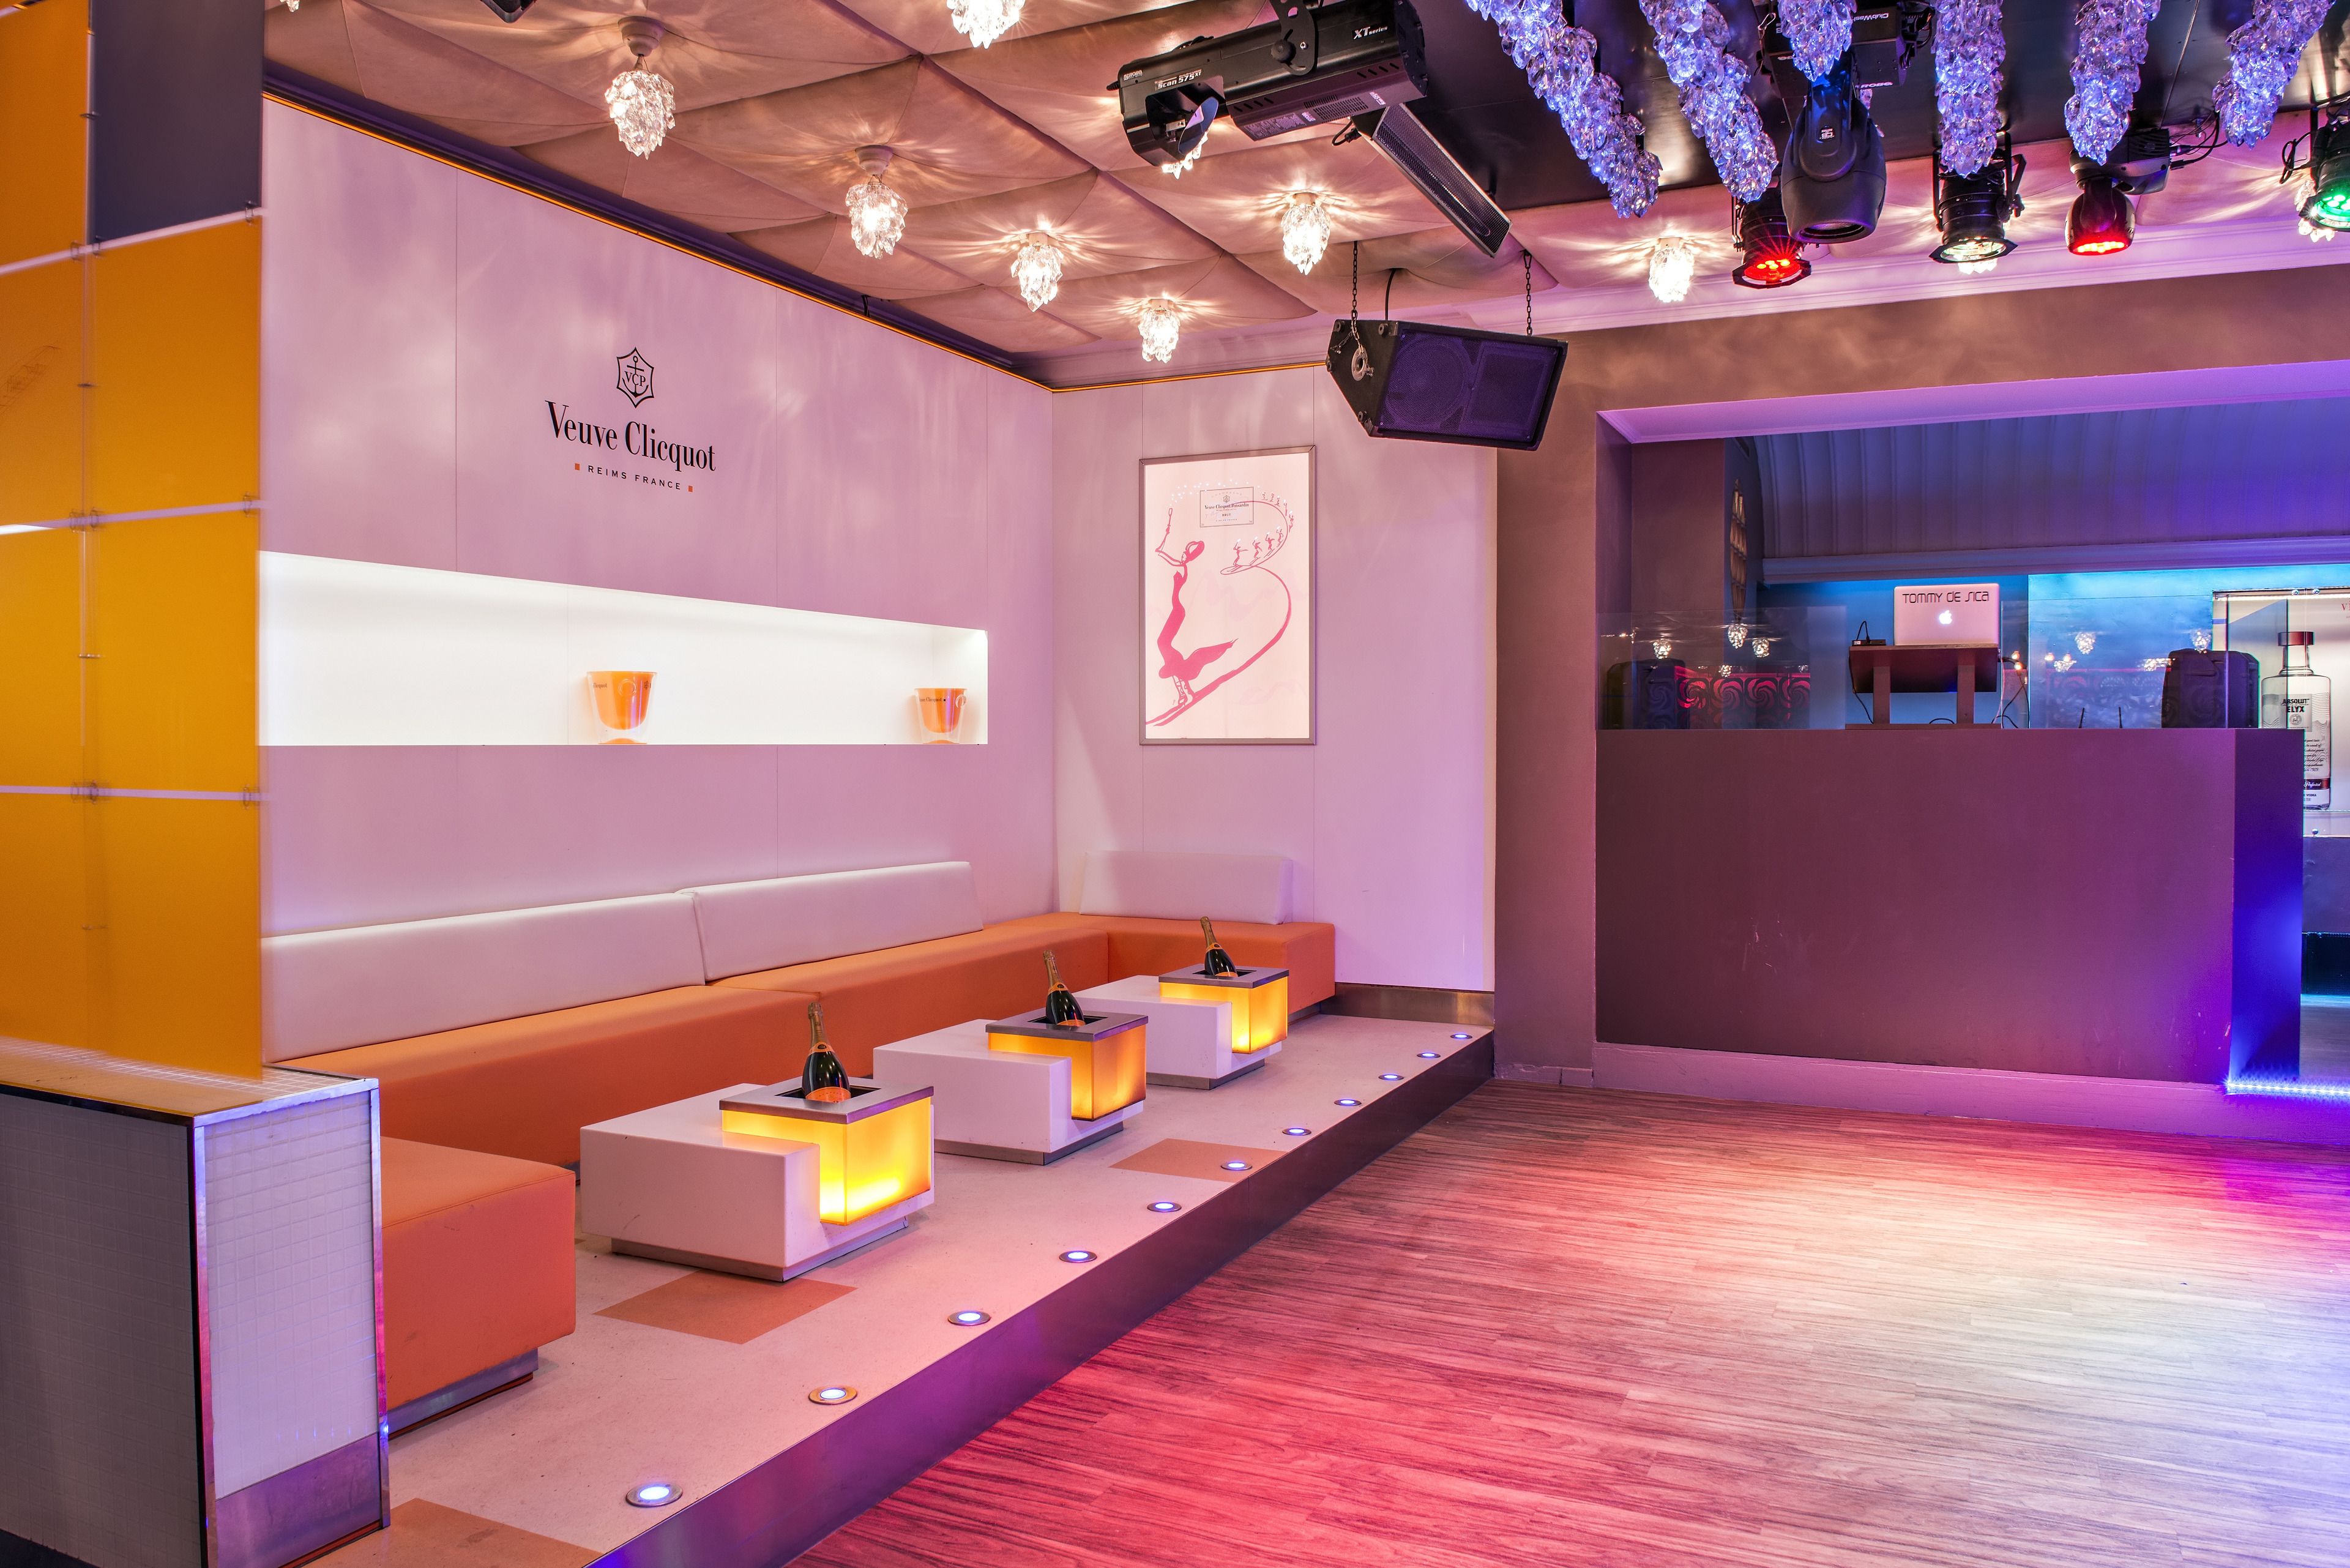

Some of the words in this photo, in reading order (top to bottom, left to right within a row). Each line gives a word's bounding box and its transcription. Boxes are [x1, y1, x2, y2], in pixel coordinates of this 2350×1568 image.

[1158, 79, 1177, 89] Scan
[624, 370, 646, 387] VCP
[545, 400, 617, 450] Veuve
[625, 420, 717, 472] Clicquot
[588, 465, 627, 480] REIMS
[635, 474, 681, 490] FRANCE
[1902, 592, 1943, 603] TOMMY
